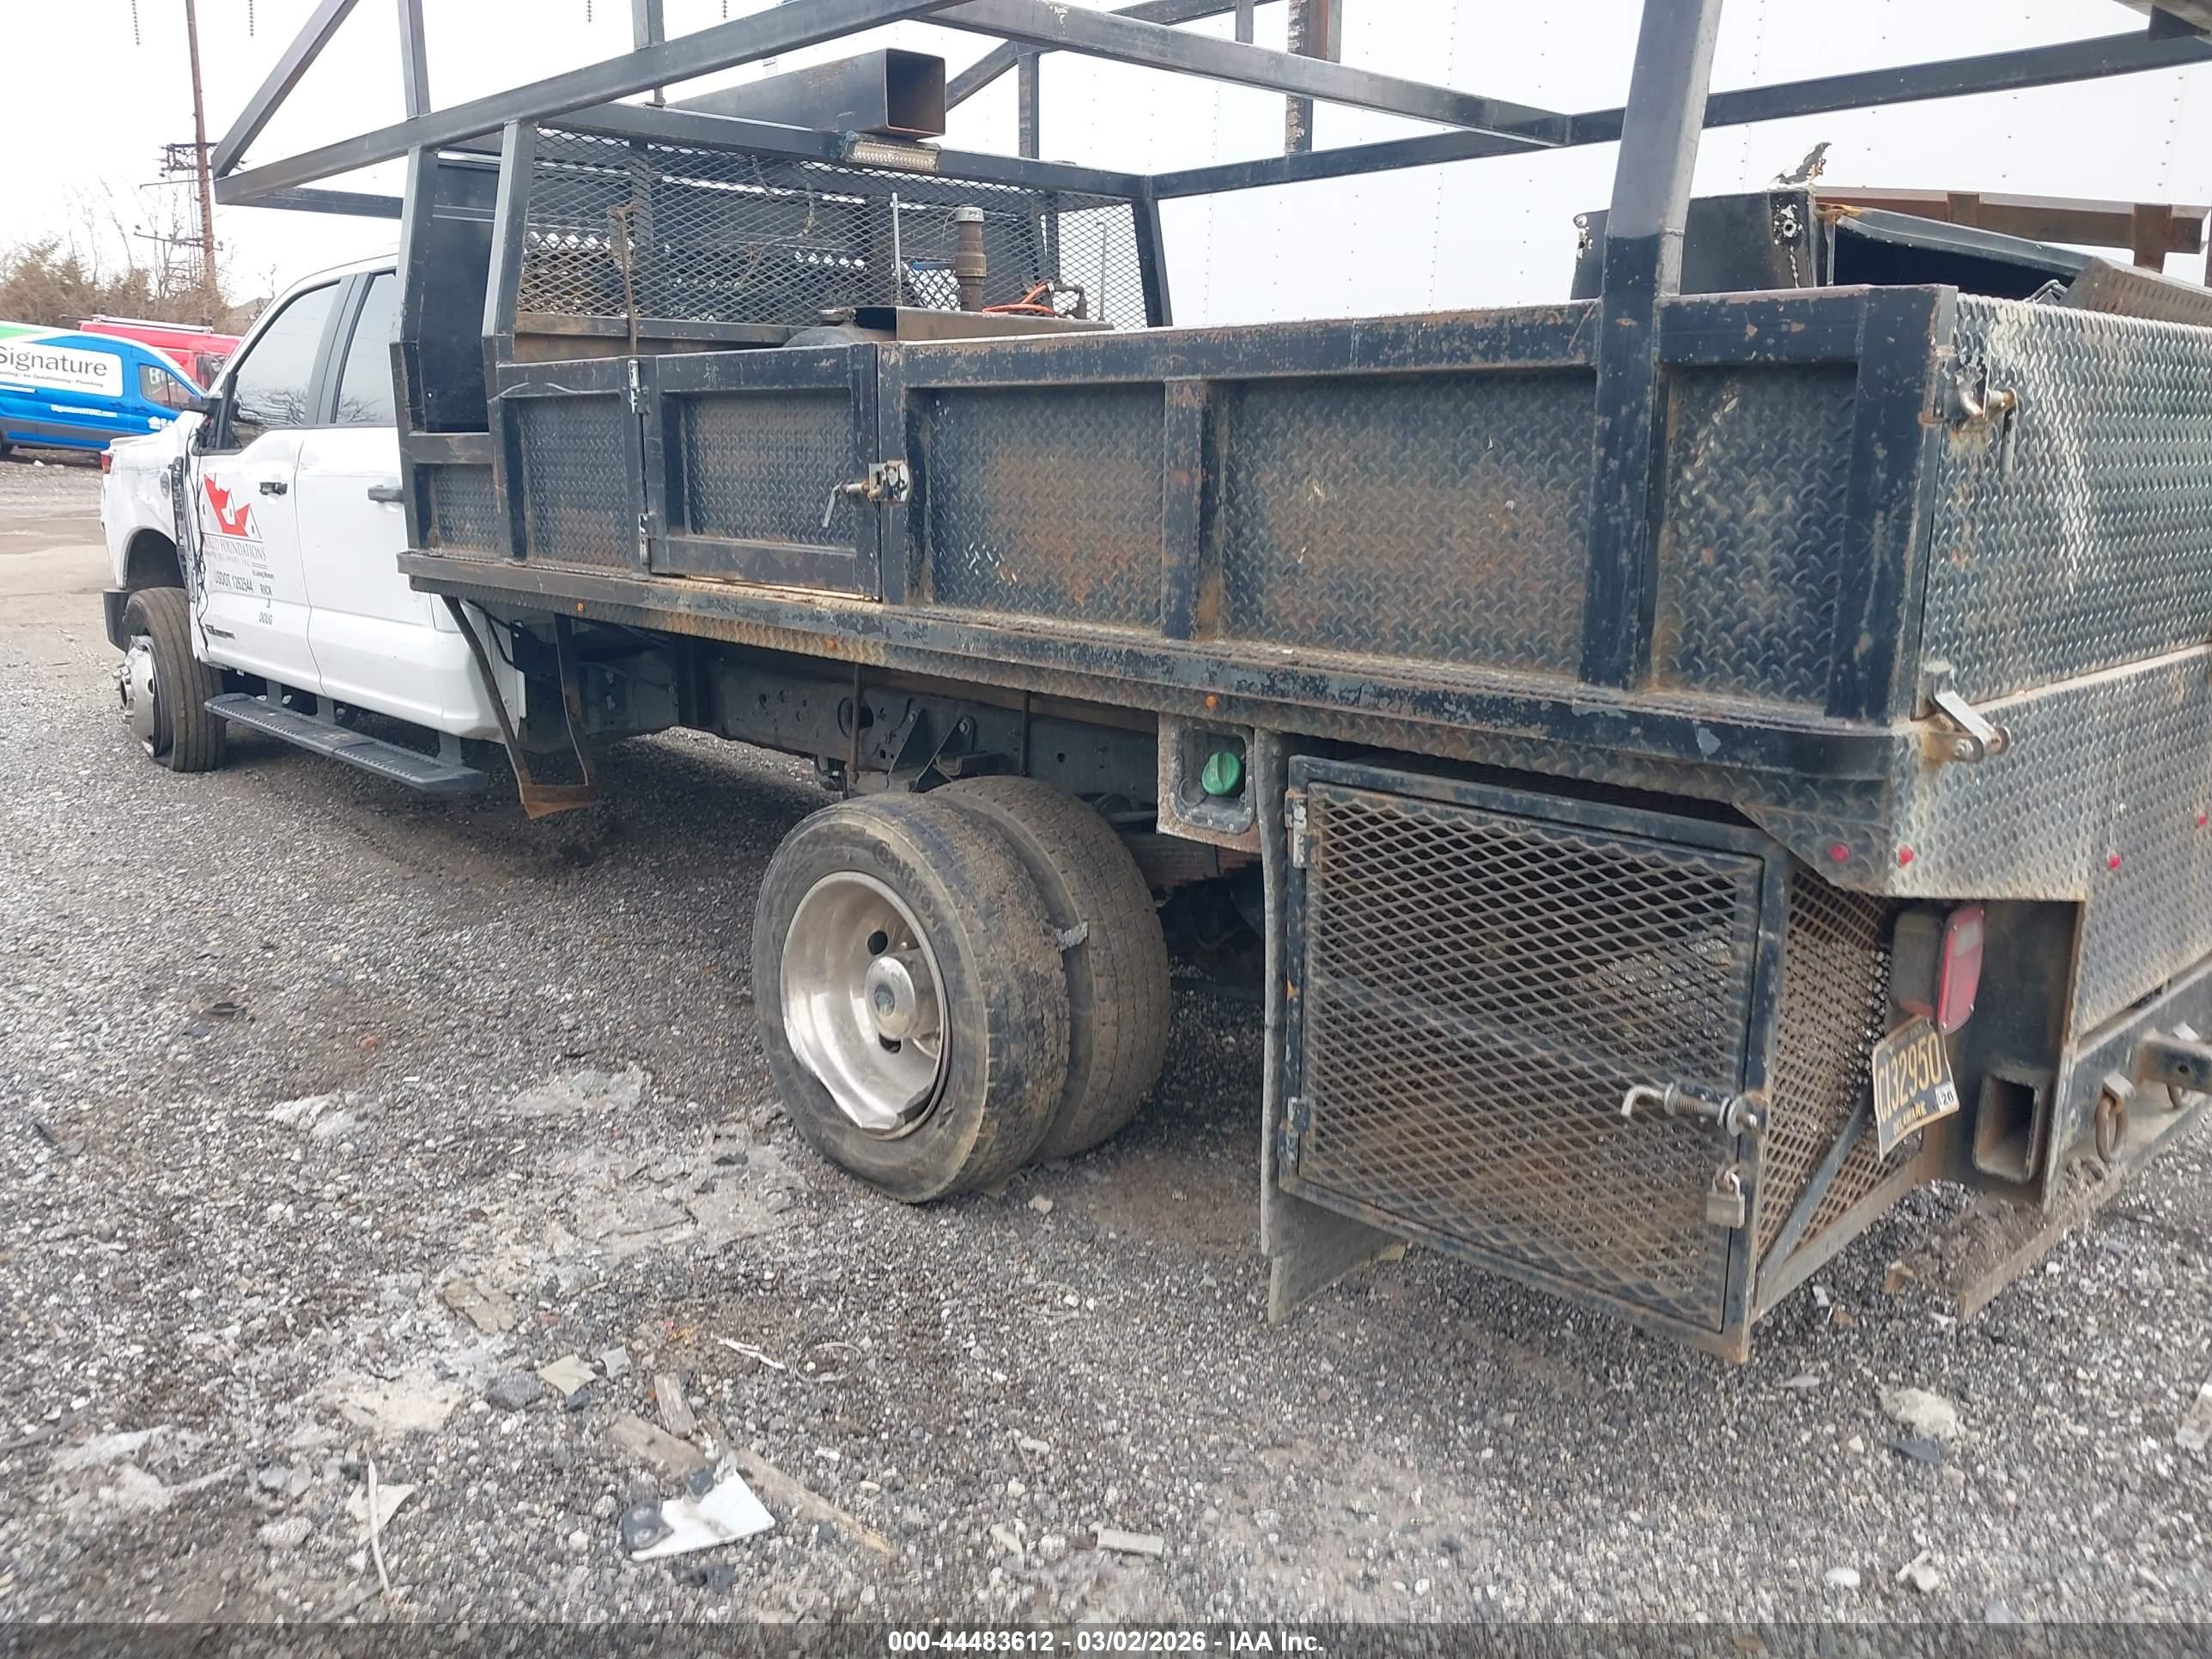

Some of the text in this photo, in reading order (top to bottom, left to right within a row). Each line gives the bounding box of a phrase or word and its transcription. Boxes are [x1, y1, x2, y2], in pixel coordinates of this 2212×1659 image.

[0, 345, 107, 377] Signature
[220, 539, 267, 562] FOUNDATIONS
[214, 570, 230, 587] USDOT
[1893, 1099, 1928, 1135] DELAWARE
